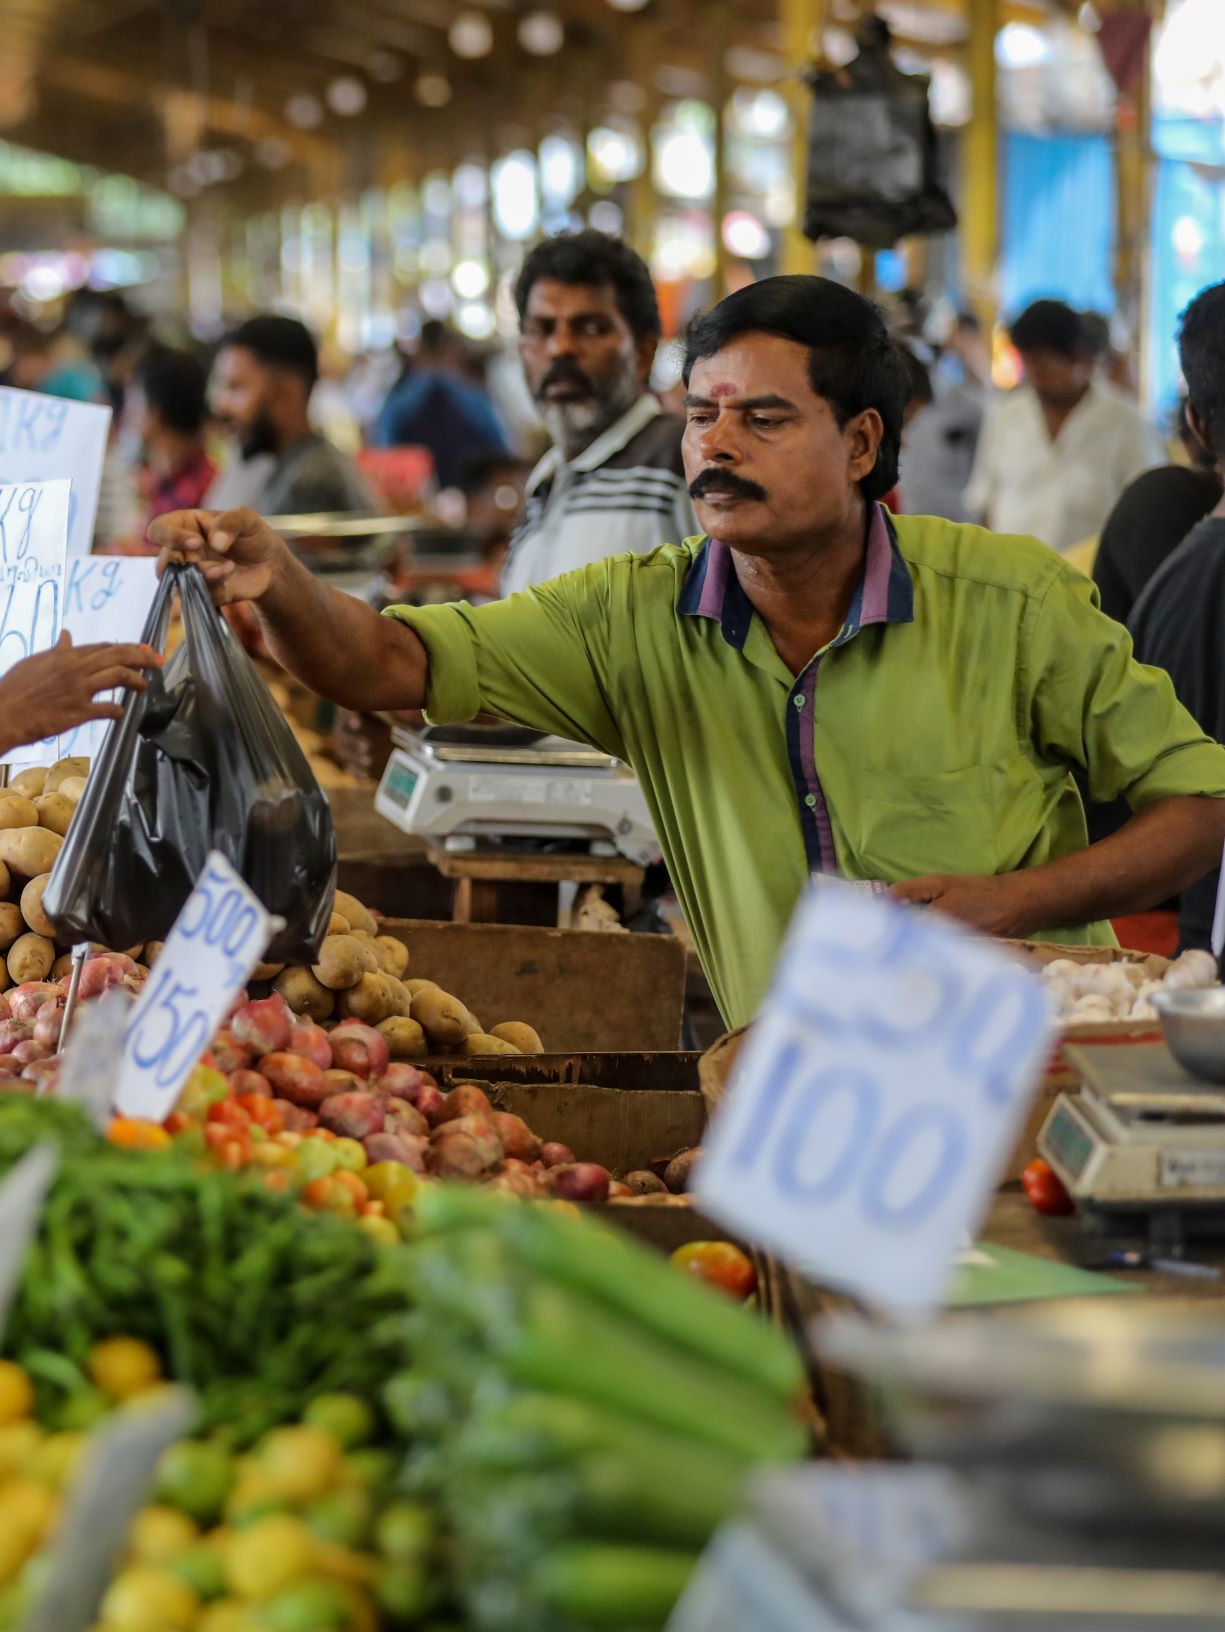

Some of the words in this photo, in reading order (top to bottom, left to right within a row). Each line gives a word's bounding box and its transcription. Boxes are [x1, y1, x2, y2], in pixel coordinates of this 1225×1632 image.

[178, 869, 259, 959] 500
[124, 968, 210, 1088] 150
[726, 1038, 971, 1236] 100
